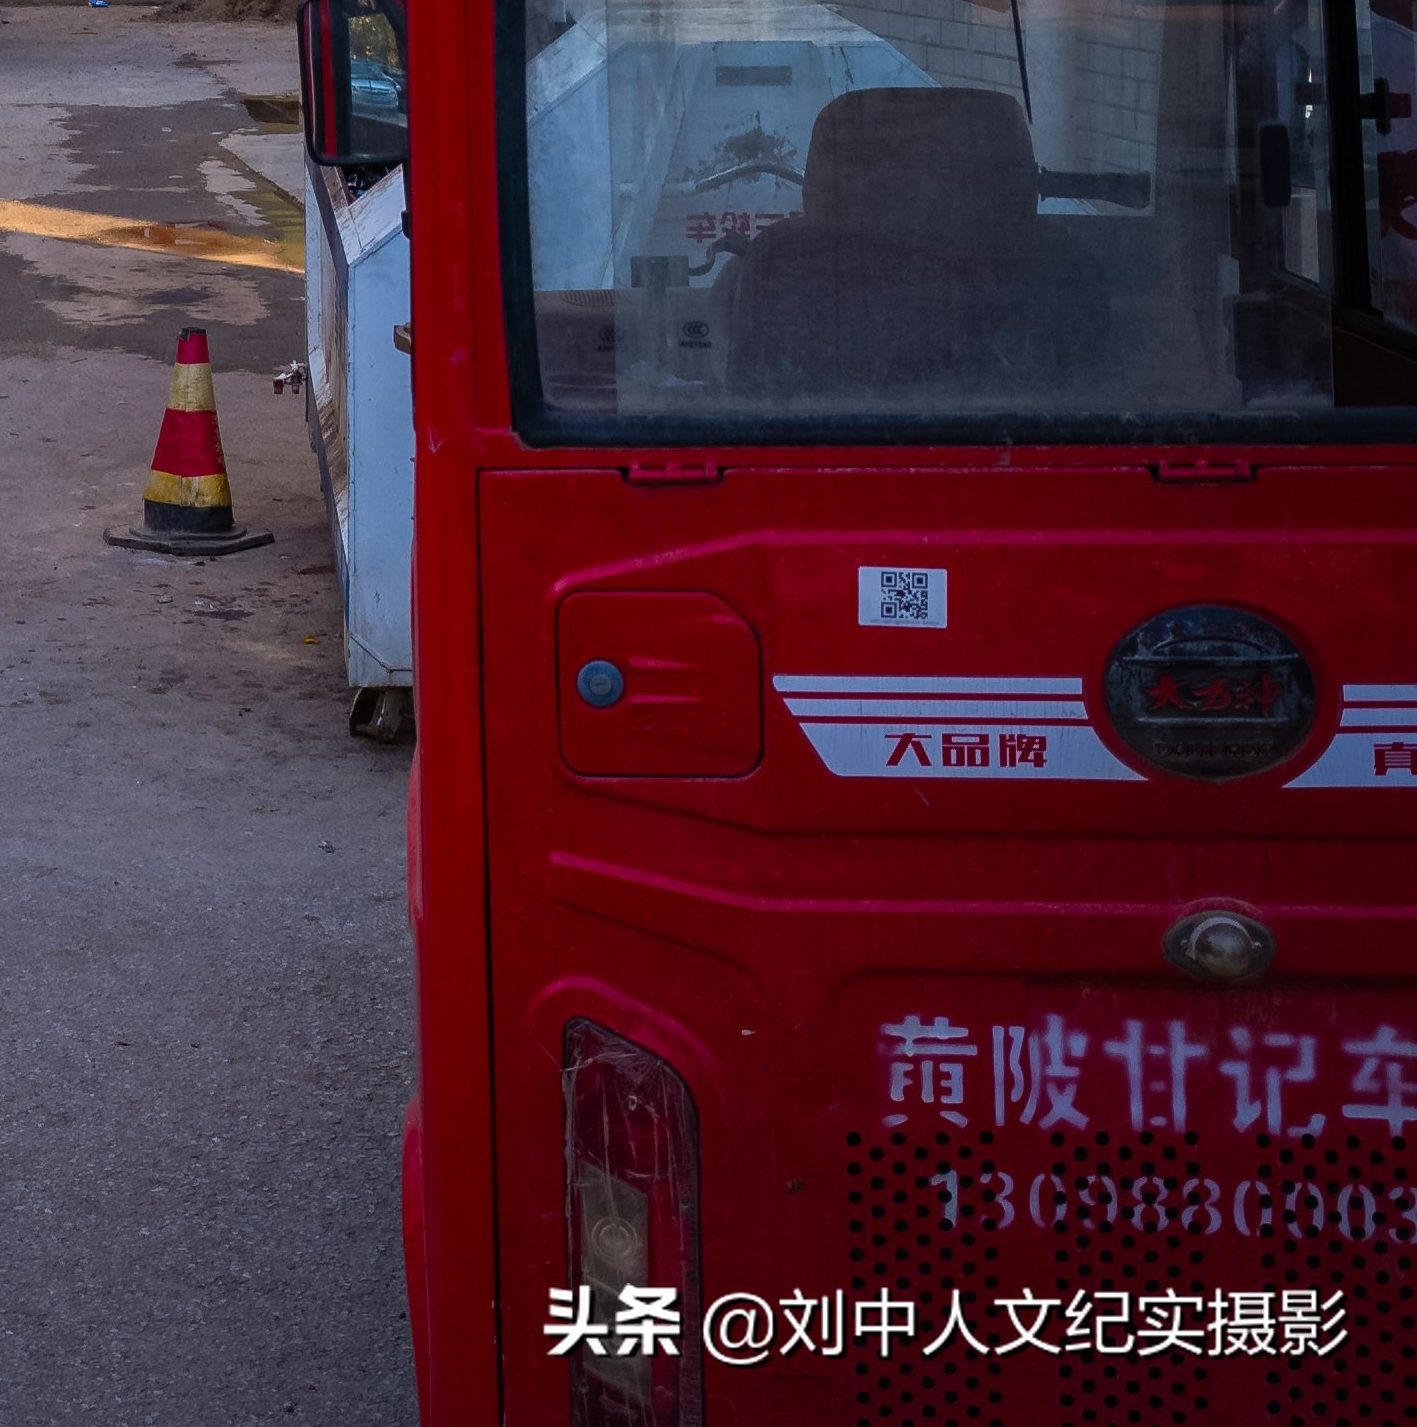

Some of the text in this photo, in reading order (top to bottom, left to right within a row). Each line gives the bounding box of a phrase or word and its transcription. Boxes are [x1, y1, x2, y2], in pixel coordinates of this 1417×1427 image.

[885, 733, 1047, 767] 大品牌
[881, 1014, 1417, 1137] 黄陂甘记车
